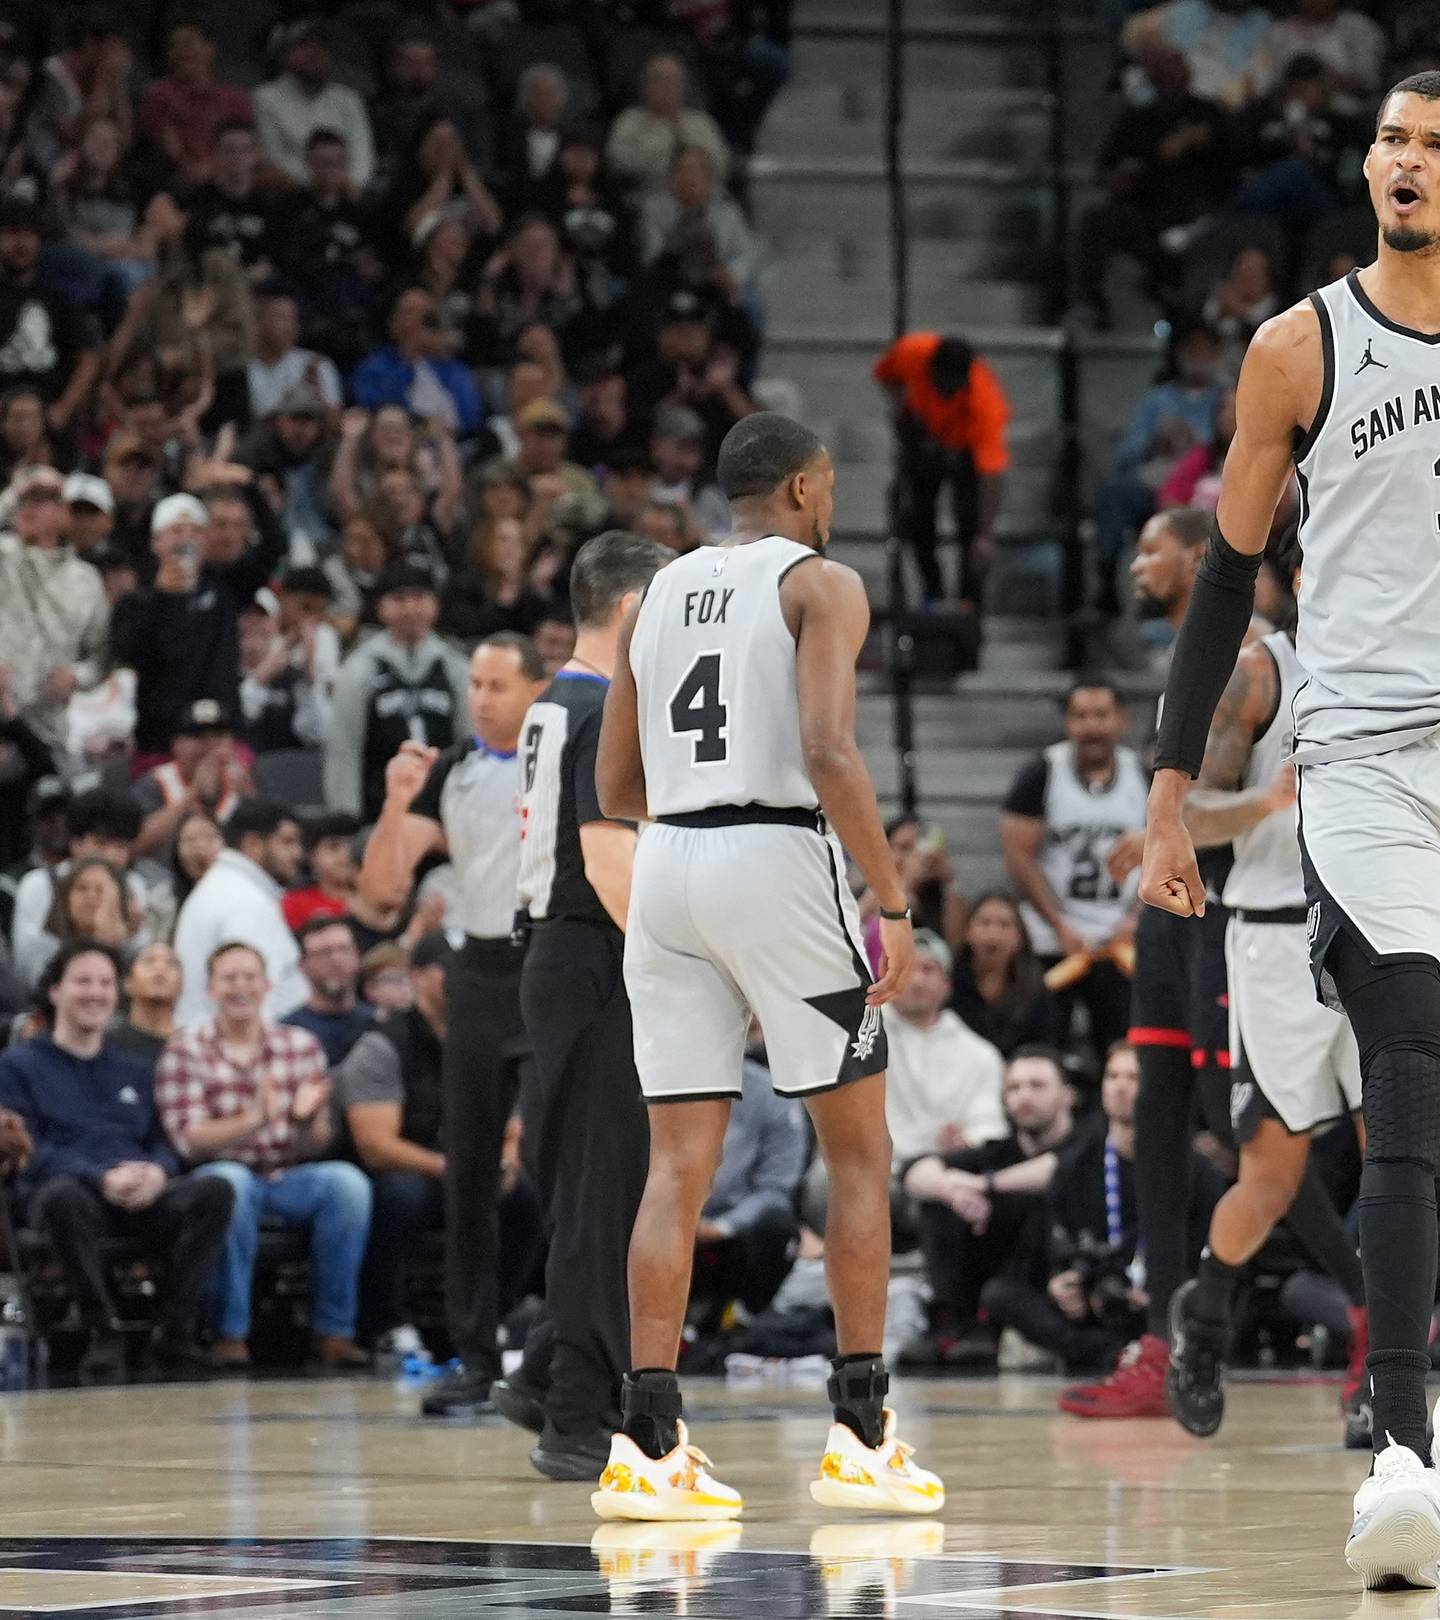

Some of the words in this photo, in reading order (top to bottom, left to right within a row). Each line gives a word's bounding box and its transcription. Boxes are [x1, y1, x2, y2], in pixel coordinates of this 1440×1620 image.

[1350, 395, 1405, 460] SAN
[684, 587, 735, 628] FOX
[668, 651, 728, 764] 4
